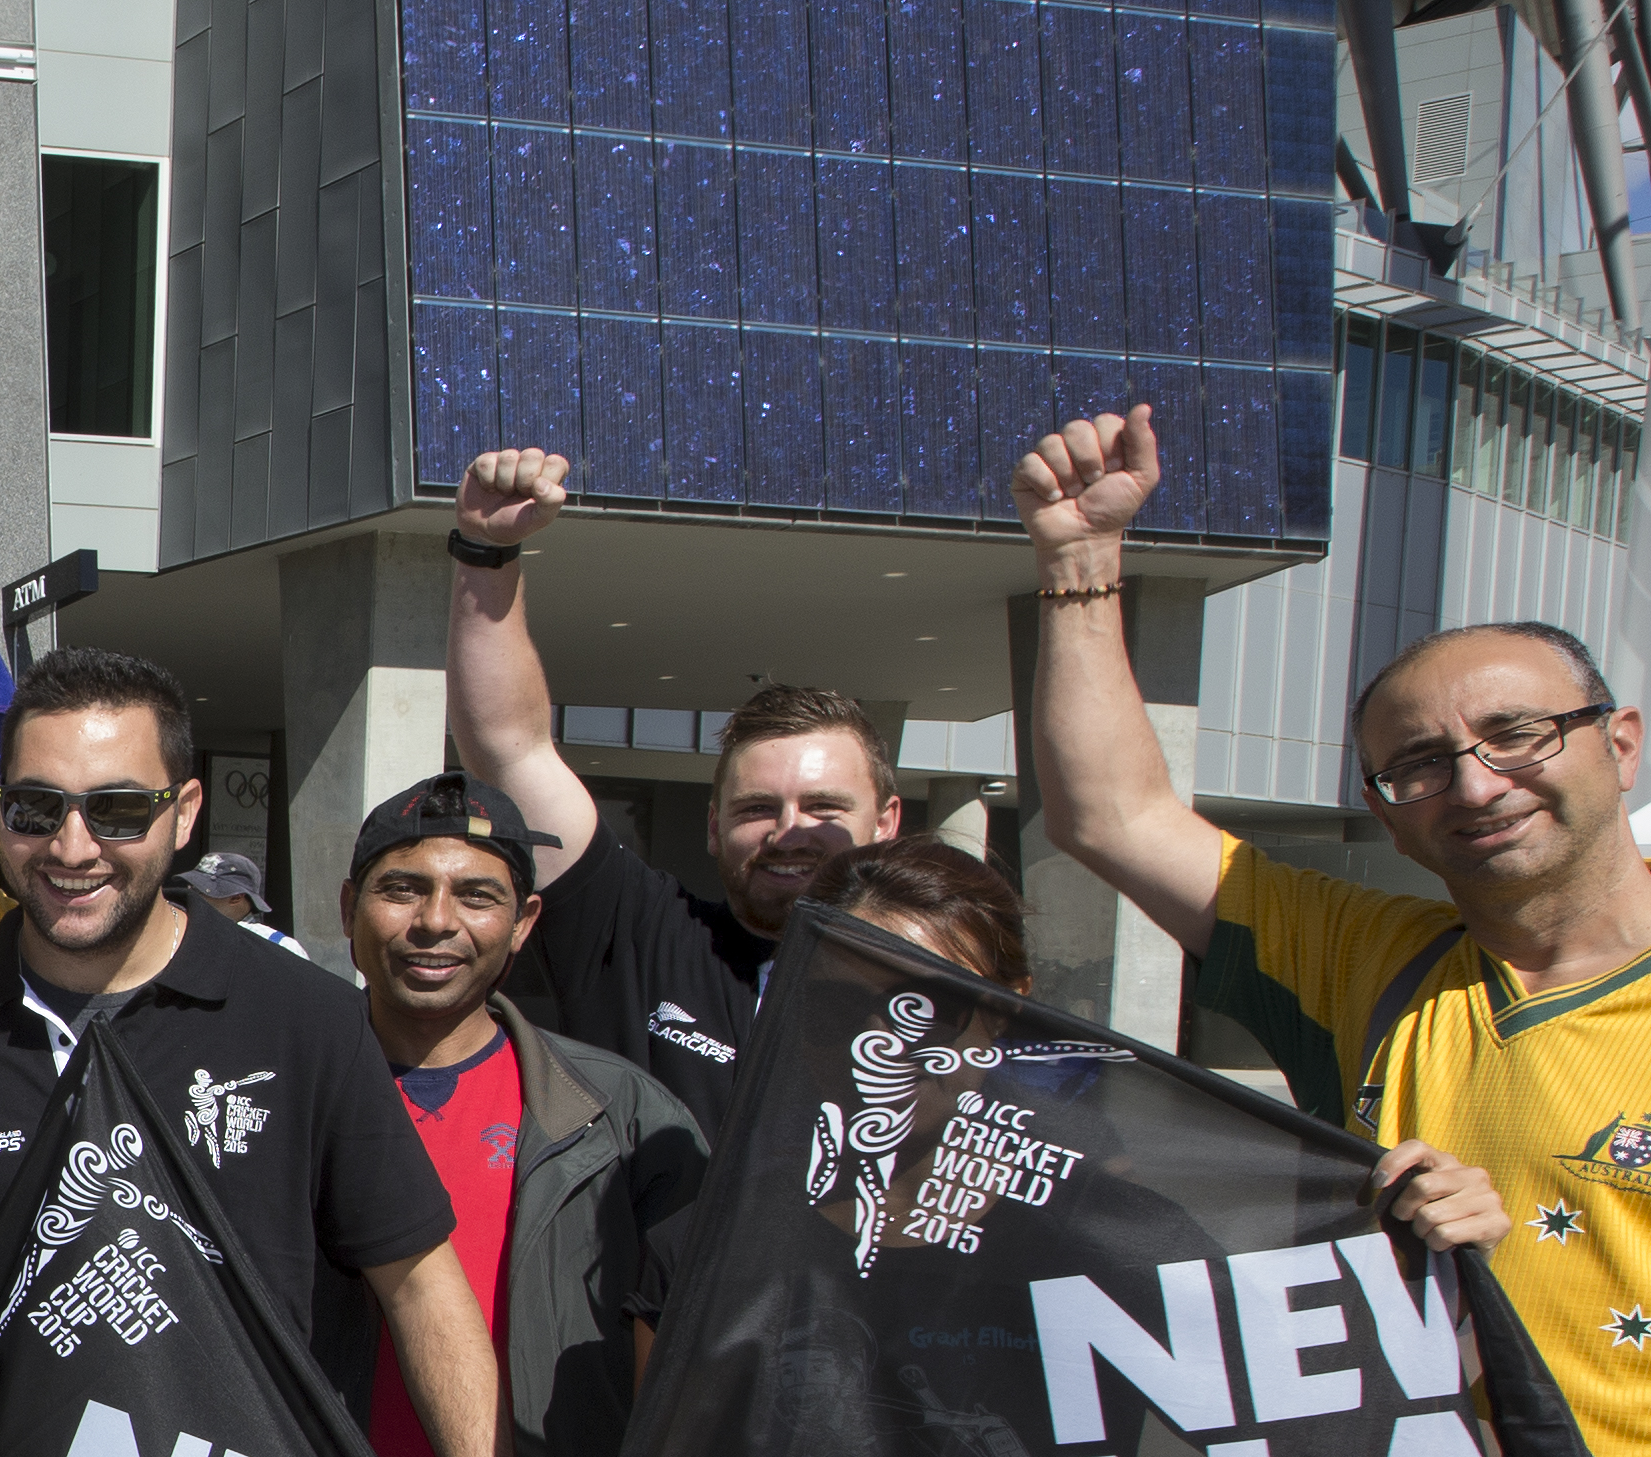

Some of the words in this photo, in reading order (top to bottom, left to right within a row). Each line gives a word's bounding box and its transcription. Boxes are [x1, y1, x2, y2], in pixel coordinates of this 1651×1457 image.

[12, 574, 46, 612] ATM
[648, 1018, 733, 1064] BLACKCAPS
[226, 1104, 271, 1122] CRICKET
[237, 1095, 252, 1107] ICC
[984, 1100, 1036, 1130] ICC
[224, 1127, 246, 1141] CUP
[226, 1115, 263, 1132] WORLD
[223, 1139, 248, 1154] 2015
[942, 1116, 1085, 1180] CRICKET
[932, 1146, 1054, 1207] WORLD
[916, 1177, 987, 1218] CUP
[902, 1208, 984, 1254] 2015
[130, 1246, 167, 1280] ICC
[49, 1282, 98, 1327] CUP
[71, 1261, 148, 1346] WORLD
[93, 1243, 179, 1334] CRICKET
[27, 1301, 82, 1358] 2015
